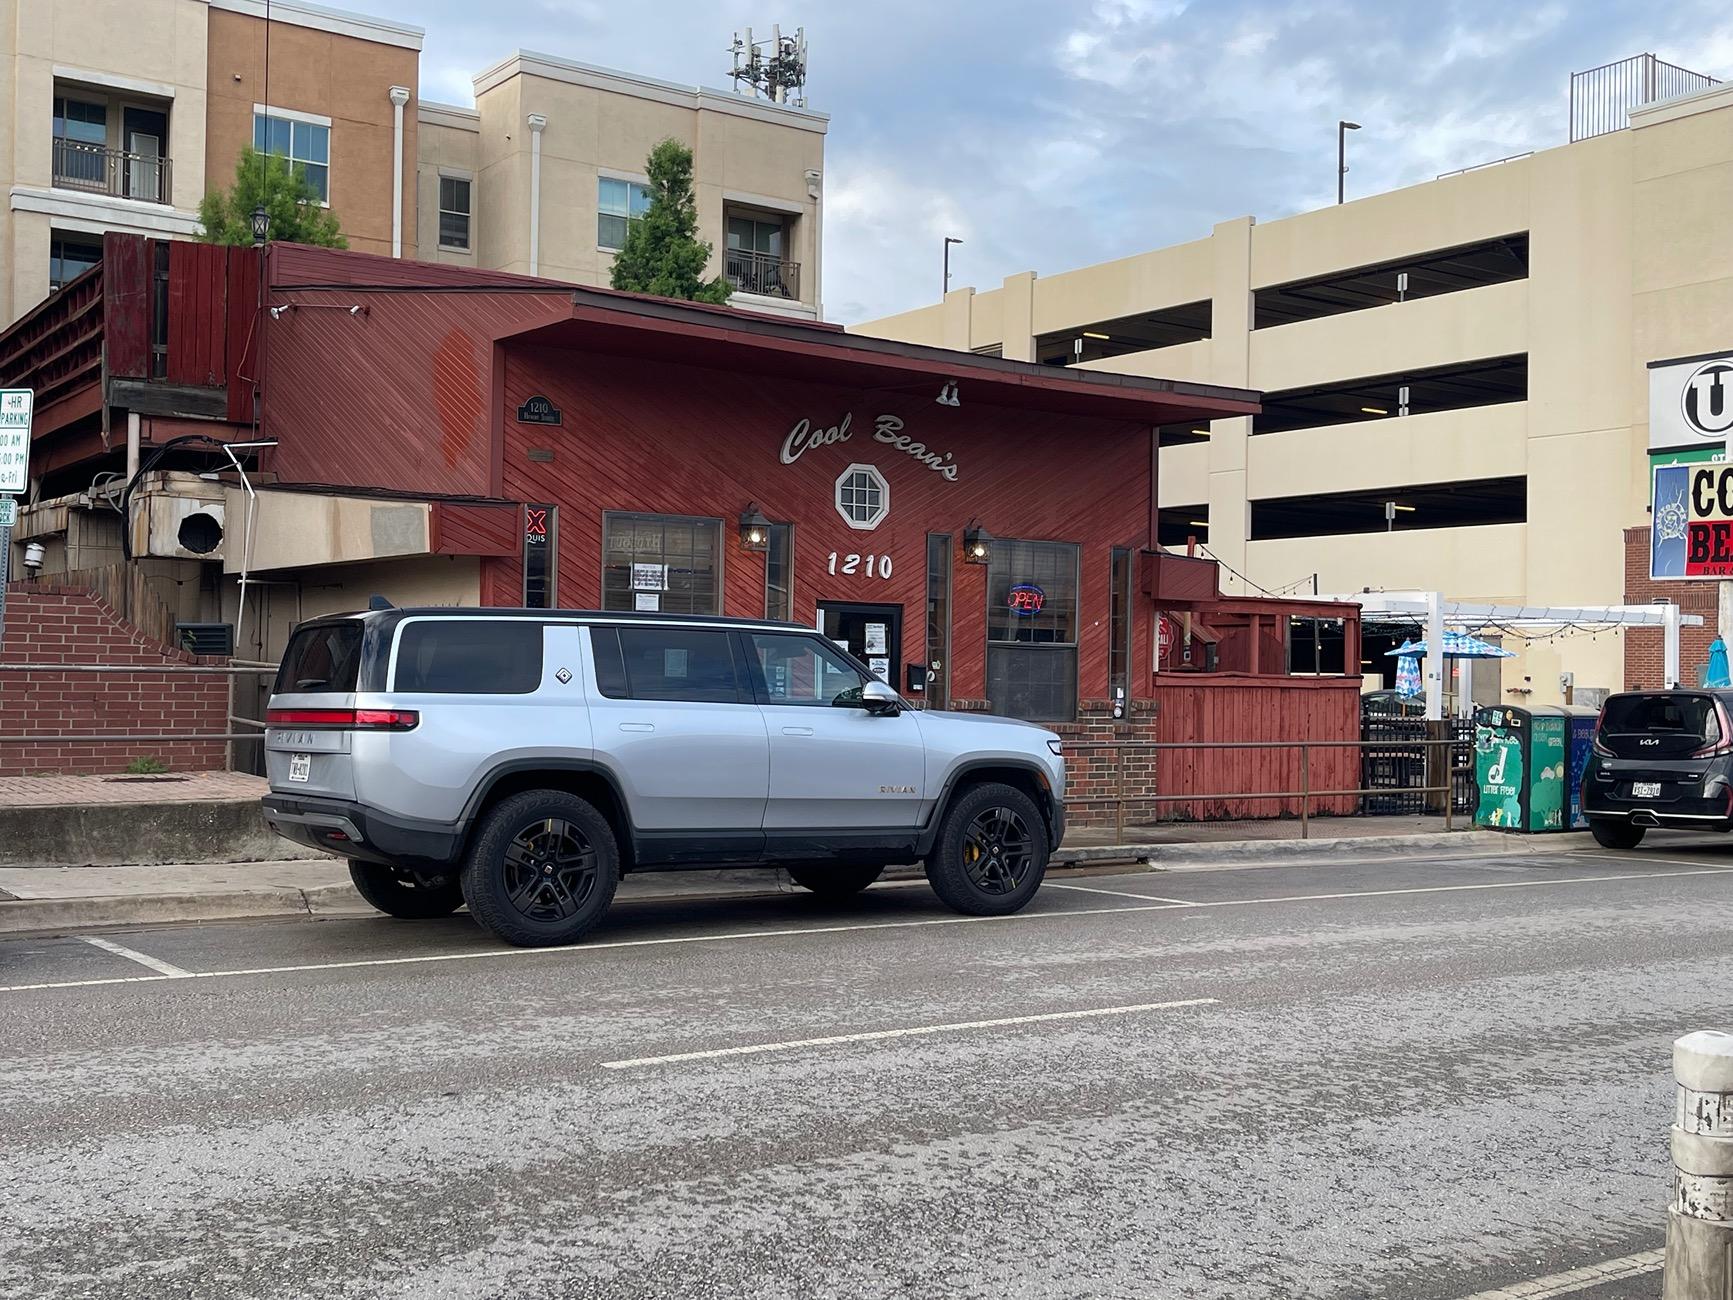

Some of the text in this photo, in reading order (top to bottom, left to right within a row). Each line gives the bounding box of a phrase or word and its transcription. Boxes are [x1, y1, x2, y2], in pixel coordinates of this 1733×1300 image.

[530, 402, 548, 413] 1210
[0, 412, 28, 425] PARKING
[11, 434, 21, 446] AM
[780, 412, 959, 482] Cool Bean's
[15, 453, 25, 465] PM
[1689, 524, 1733, 563] BE
[827, 551, 893, 580] 1210
[1703, 565, 1727, 576] BAR
[1008, 592, 1044, 610] OPEN
[880, 785, 917, 794] RIVIAN
